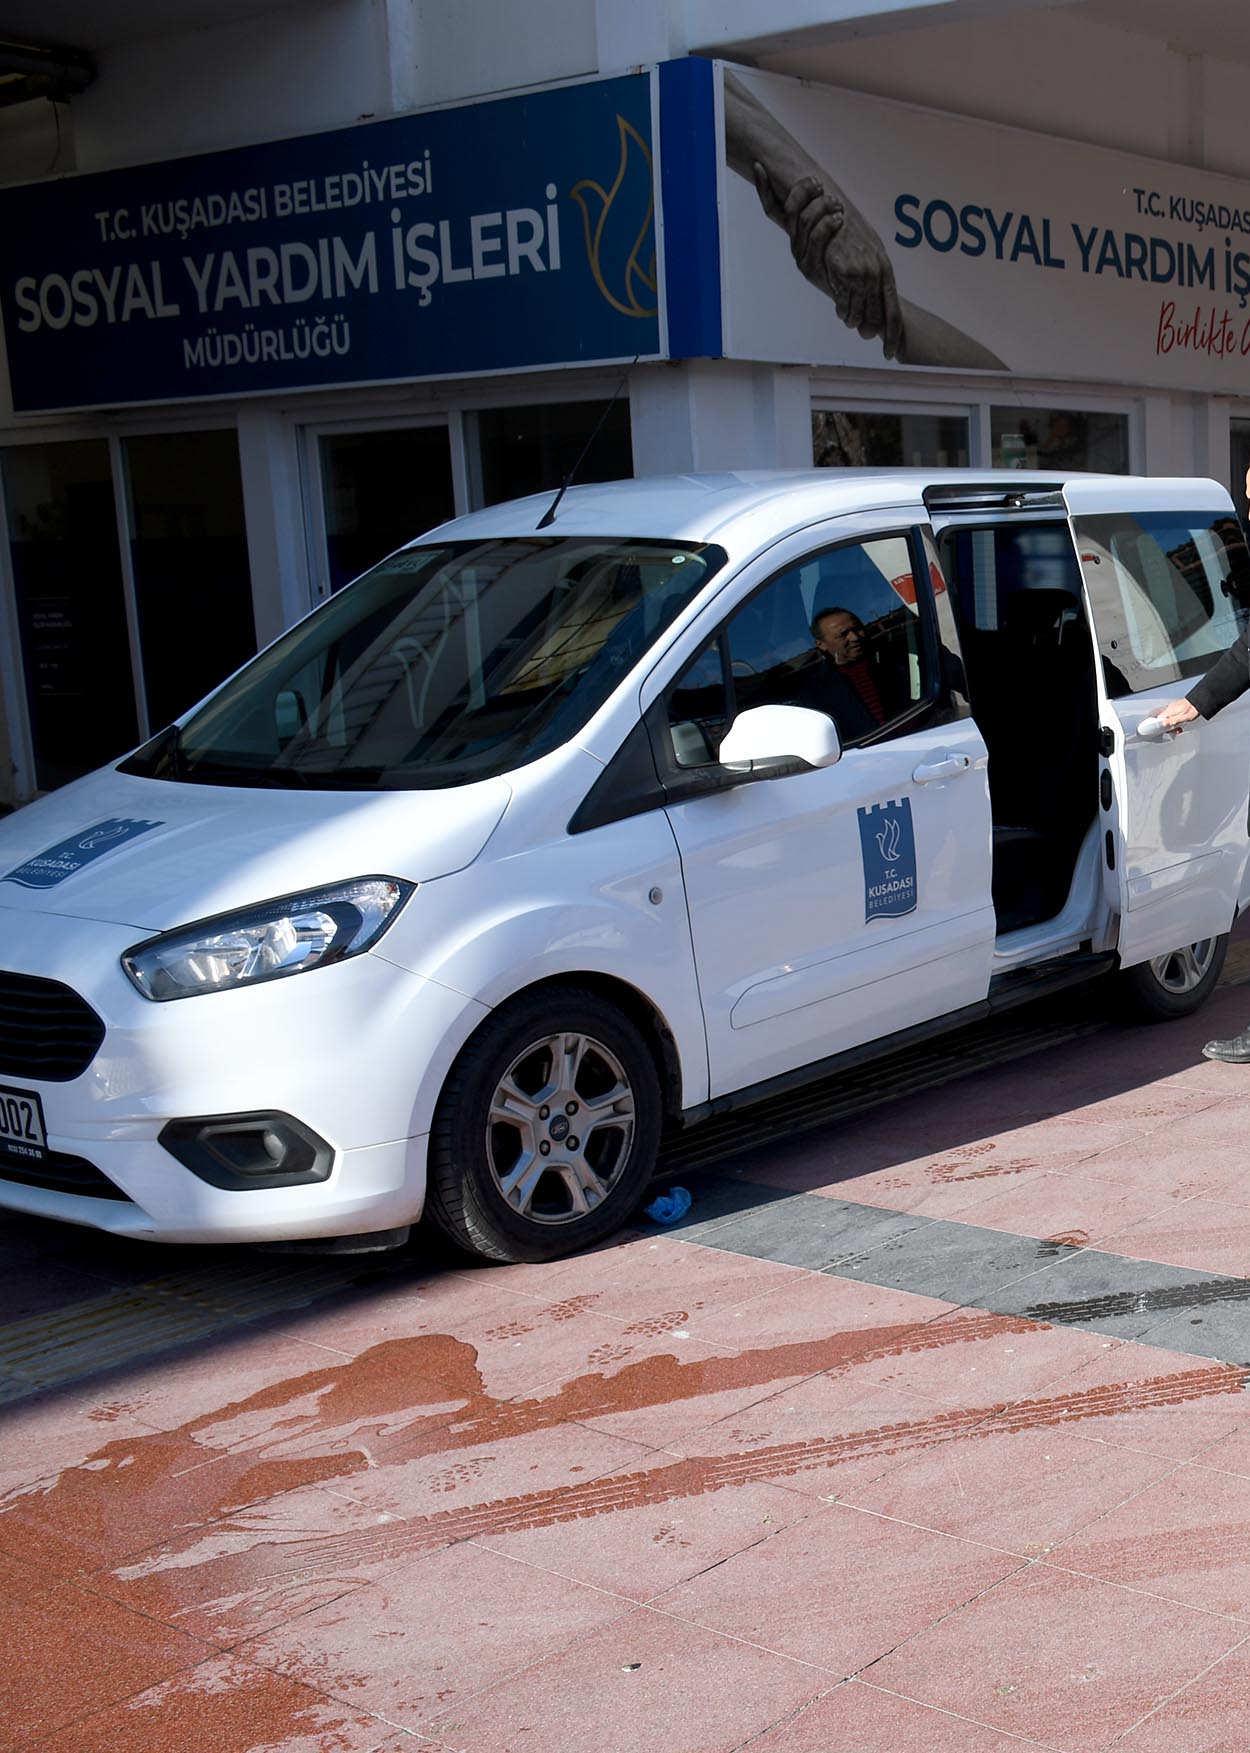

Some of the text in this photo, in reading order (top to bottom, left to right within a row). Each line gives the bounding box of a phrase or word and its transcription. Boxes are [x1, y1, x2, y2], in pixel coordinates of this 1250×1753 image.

[95, 149, 432, 242] T.C. KUŞADASI BELEDİYESİ
[1133, 189, 1165, 219] T.C.
[14, 184, 561, 332] SOSYAL YARDIM İŞLERİ
[893, 194, 1065, 269] SOSYAL
[1072, 223, 1215, 290] YARDIM
[182, 314, 350, 369] MÜDÜRLÜĞÜ
[1157, 302, 1236, 358] Birlikte
